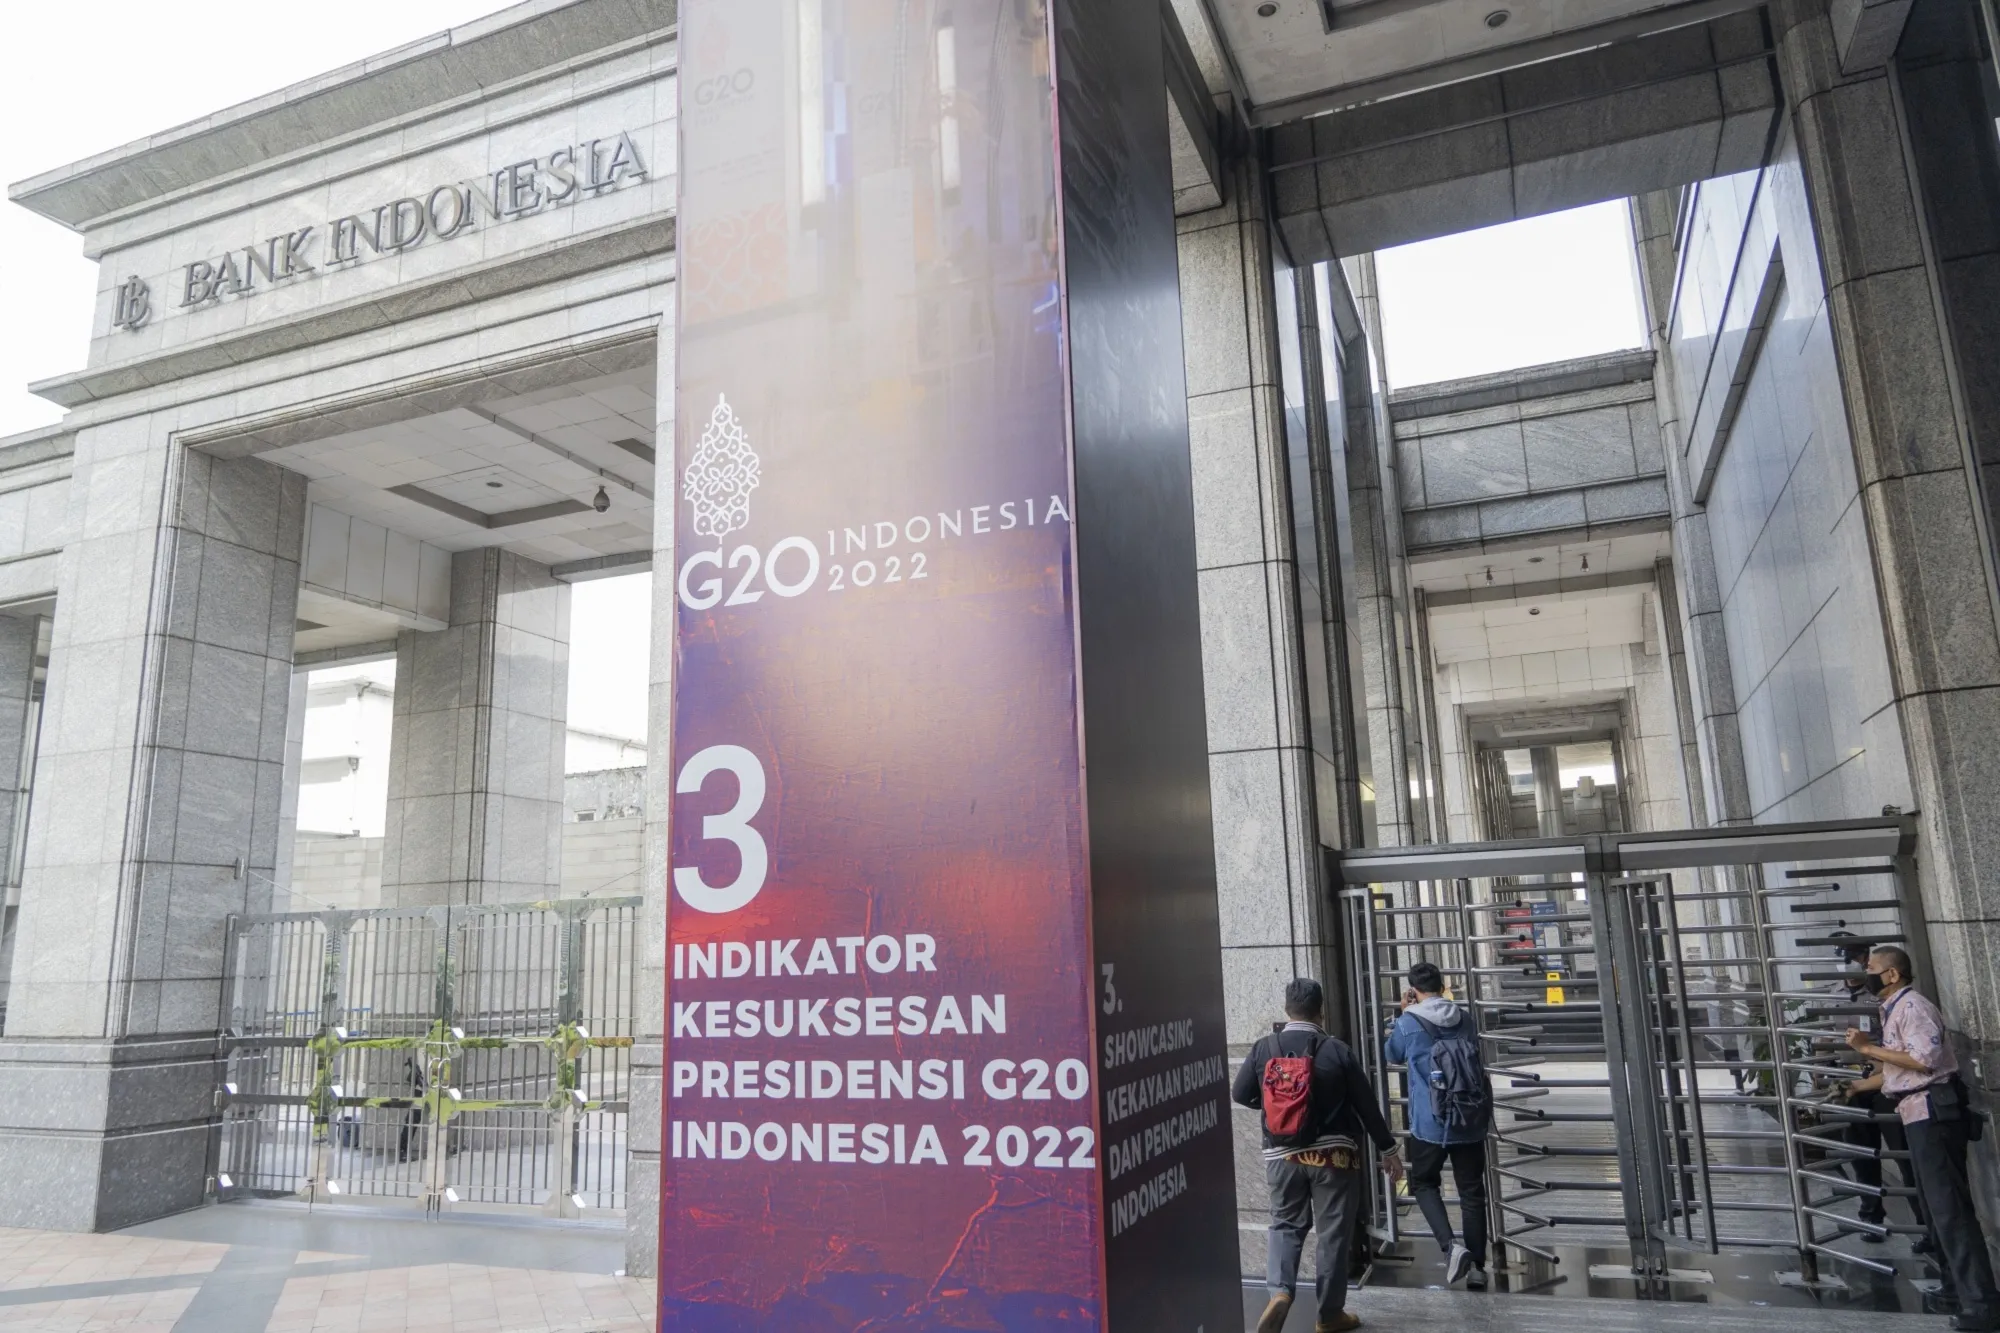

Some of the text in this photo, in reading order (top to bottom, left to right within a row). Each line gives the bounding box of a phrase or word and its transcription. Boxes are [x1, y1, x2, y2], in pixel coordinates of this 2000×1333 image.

[179, 130, 648, 307] BANK INDONESIA
[827, 494, 1070, 556] INDONESIA
[678, 535, 820, 611] G20
[827, 552, 928, 592] 2022
[673, 744, 768, 914] 3
[673, 933, 937, 979] INDIKATOR
[673, 994, 1006, 1038] KESUKSESAN
[1101, 963, 1123, 1015] 3.
[1104, 1018, 1194, 1069] SHOWCASING
[672, 1058, 1090, 1100] PRESIDENSI G20
[1106, 1054, 1225, 1124] KEKAYAAN BUDAYA
[672, 1120, 1096, 1168] INDONESIA 2022
[1109, 1099, 1218, 1181] DAN PENCAPAIAN
[1111, 1162, 1188, 1237] INDONESIA
